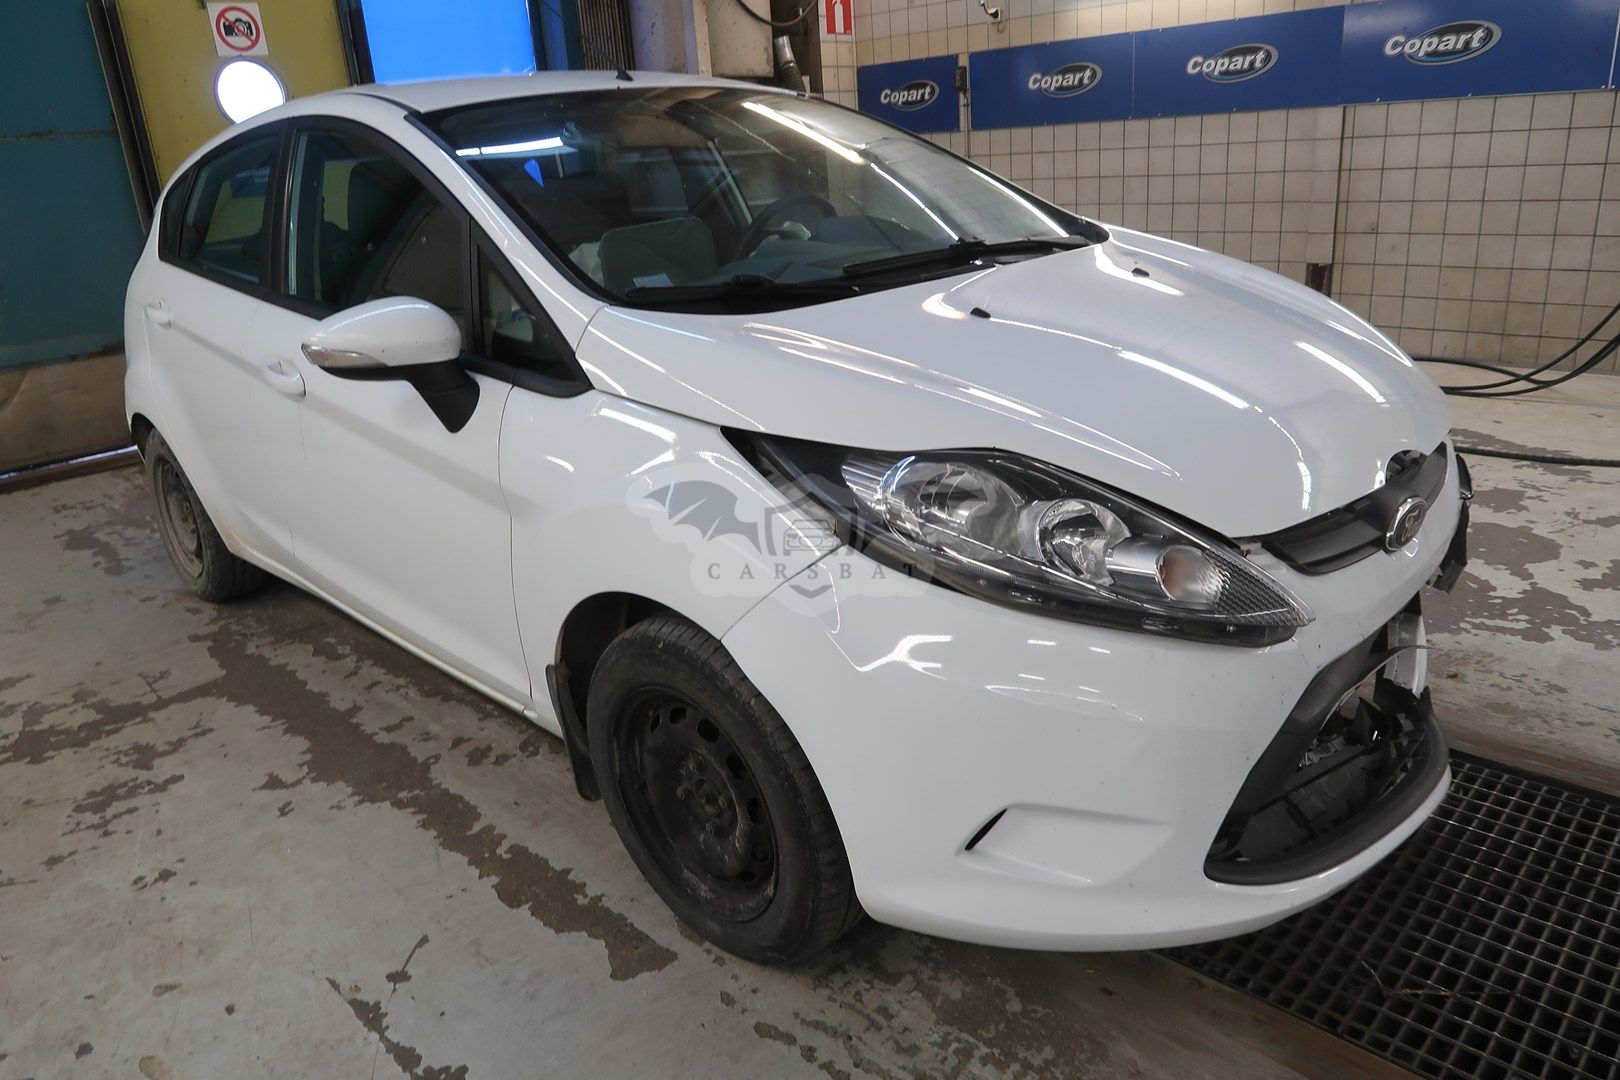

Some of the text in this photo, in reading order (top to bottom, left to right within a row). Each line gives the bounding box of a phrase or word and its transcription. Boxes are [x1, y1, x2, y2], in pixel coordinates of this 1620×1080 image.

[1385, 27, 1486, 58] Copart
[1187, 50, 1265, 76] Copart
[1028, 68, 1092, 91] Copart
[880, 85, 931, 105] Copart
